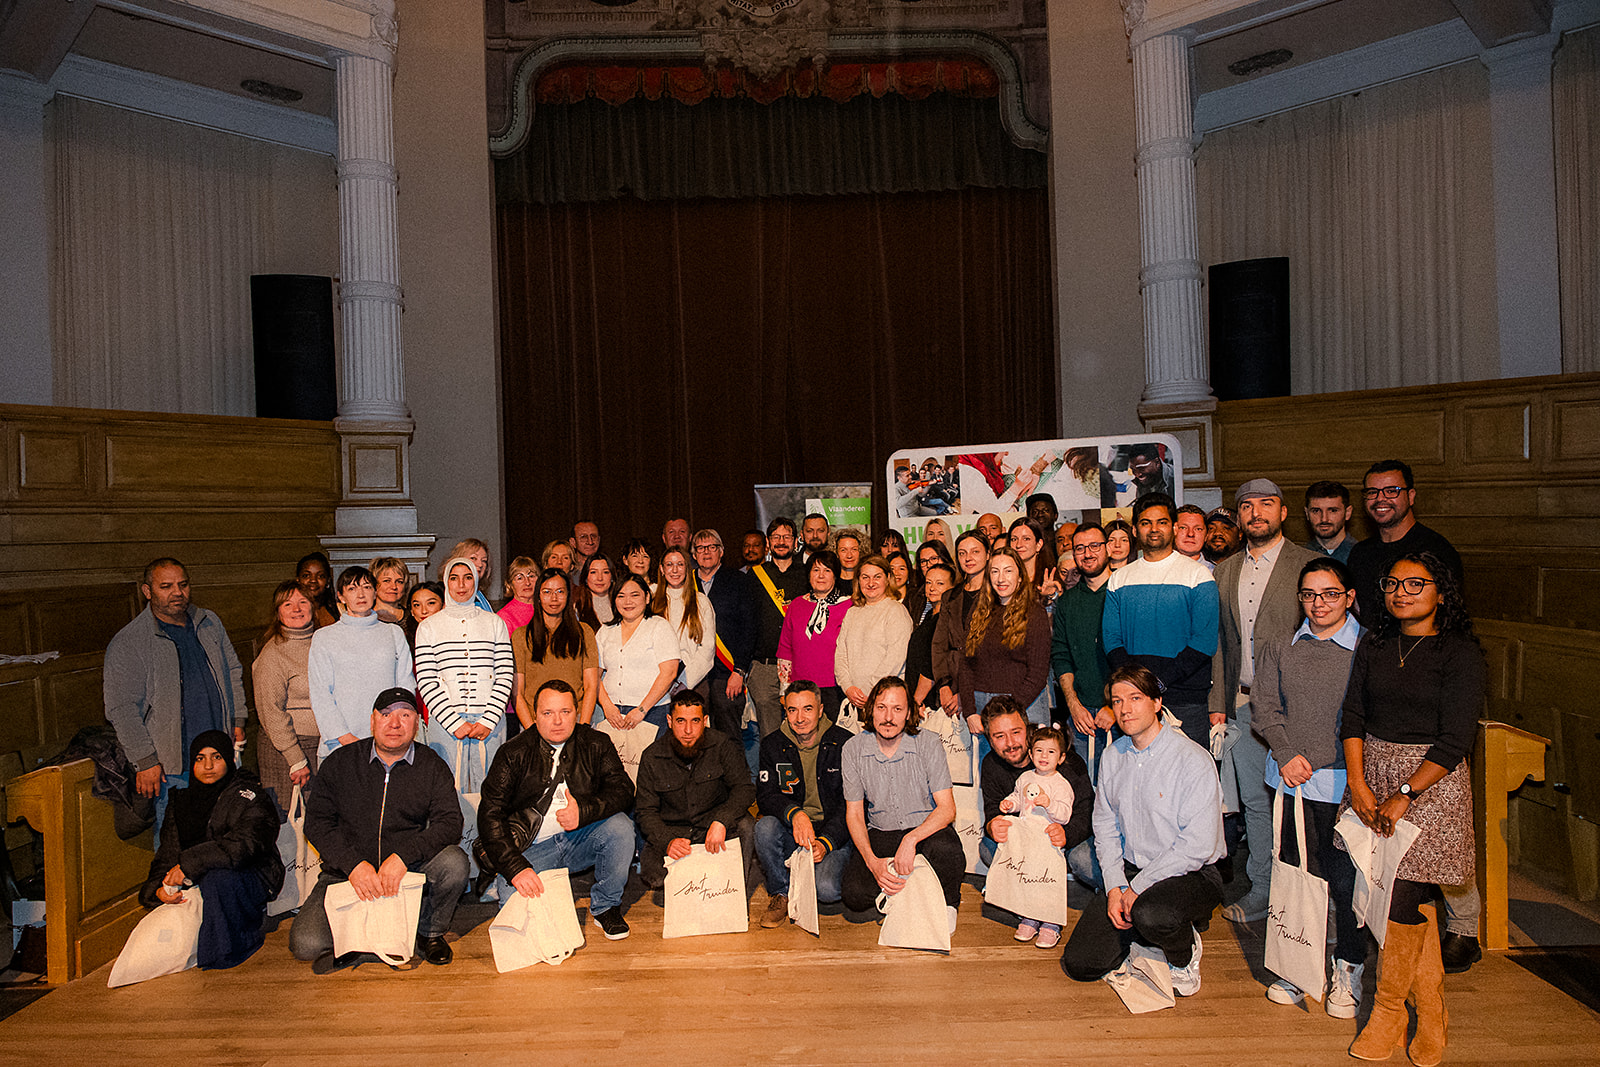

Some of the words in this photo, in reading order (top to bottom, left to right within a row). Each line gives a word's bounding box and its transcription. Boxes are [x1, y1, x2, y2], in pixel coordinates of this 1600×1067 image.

[1016, 868, 1057, 884] Truiden
[699, 879, 739, 901] Truiden
[1276, 924, 1312, 948] Truiden
